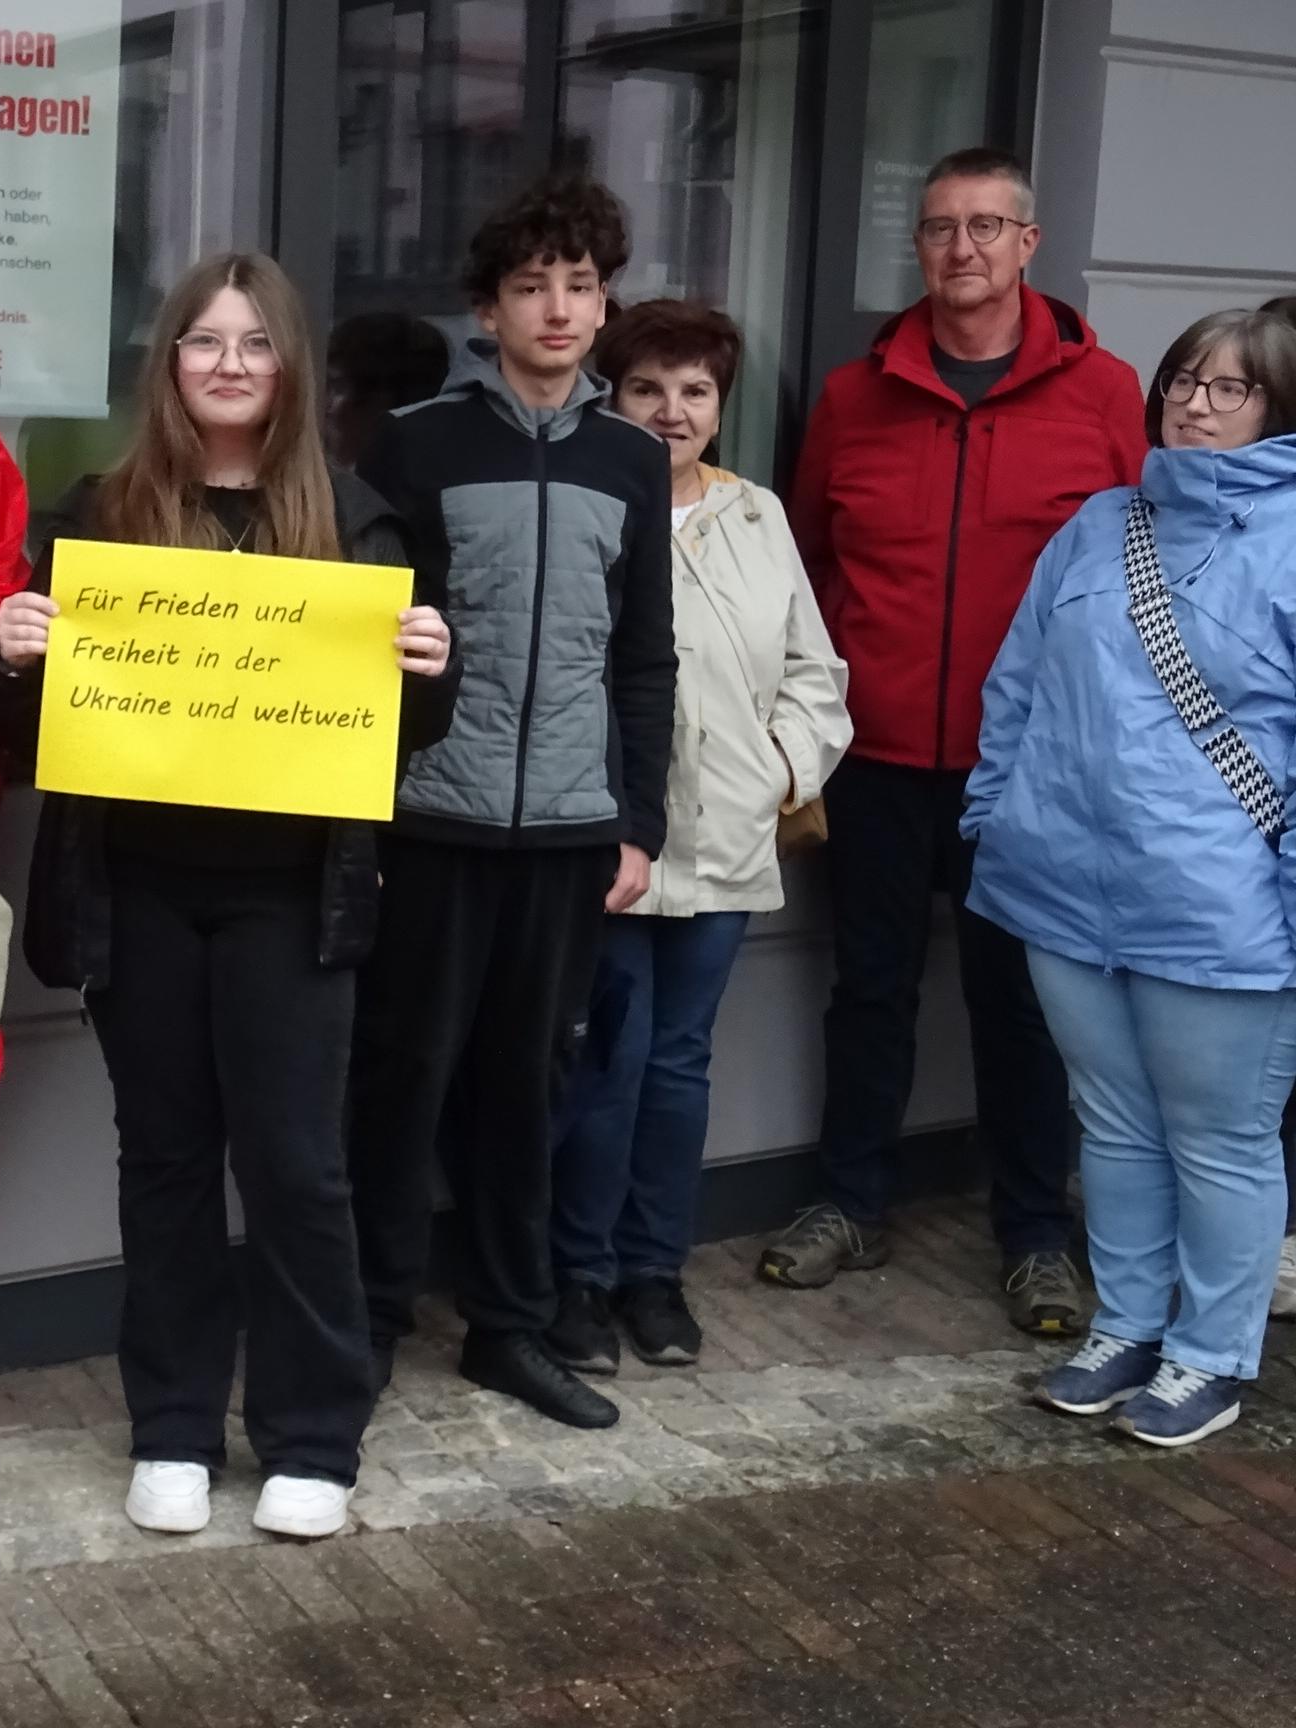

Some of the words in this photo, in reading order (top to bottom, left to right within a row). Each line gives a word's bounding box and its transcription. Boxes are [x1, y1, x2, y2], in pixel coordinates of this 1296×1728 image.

[9, 187, 42, 201] oder
[4, 209, 52, 227] haben,
[75, 587, 123, 612] Für
[137, 590, 239, 620] Frieden
[255, 600, 306, 624] und
[72, 636, 180, 665] Freiheit
[196, 646, 219, 668] in
[235, 646, 281, 672] der
[69, 685, 171, 715] Ukraine
[188, 696, 239, 720] und
[254, 700, 375, 729] weltweit
